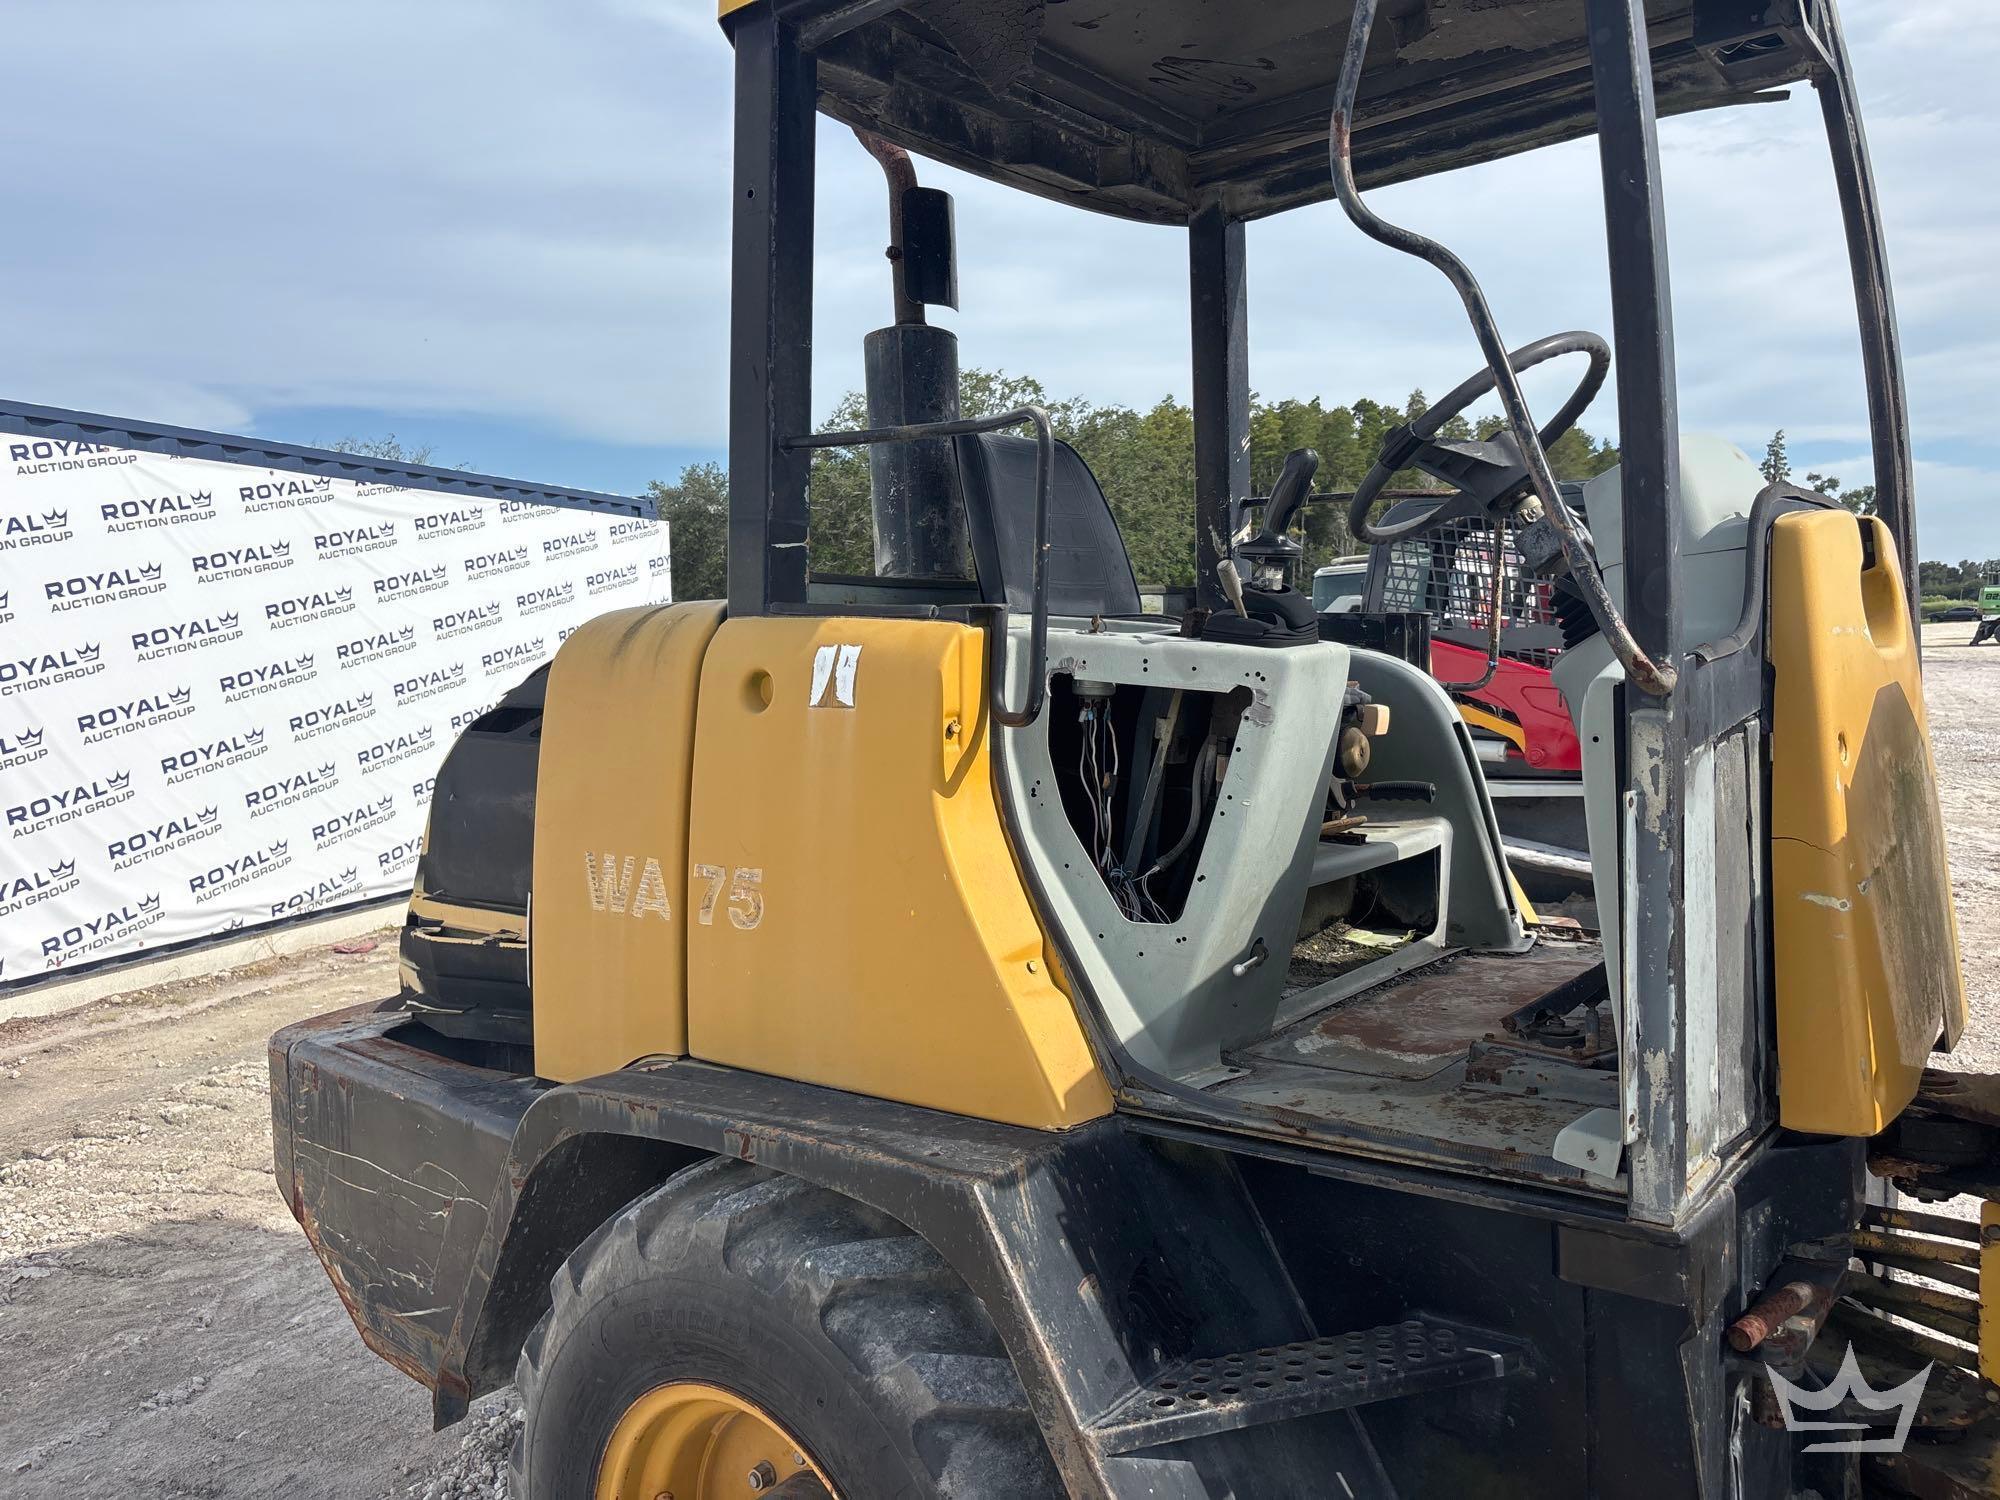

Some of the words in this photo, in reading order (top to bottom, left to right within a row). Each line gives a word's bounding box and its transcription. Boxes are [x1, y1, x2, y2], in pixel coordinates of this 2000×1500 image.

[17, 460, 84, 475] AUCTION
[87, 455, 137, 468] GROUP
[239, 480, 314, 502] ROYAL
[244, 500, 295, 513] AUCTION
[297, 494, 334, 506] GROUP
[101, 495, 191, 520] ROYAL
[414, 510, 470, 531] ROYAL
[502, 512, 534, 524] AUCTION
[107, 517, 168, 533] AUCTION
[171, 511, 216, 524] GROUP
[418, 528, 455, 541] AUCTION
[457, 522, 485, 532] GROUP
[610, 520, 648, 537] ROYAL
[20, 531, 73, 547] GROUP
[314, 527, 380, 549] ROYAL
[318, 546, 363, 560] AUCTION
[365, 539, 398, 552] GROUP
[543, 533, 586, 553] ROYAL
[612, 535, 638, 546] AUCTION
[640, 529, 659, 539] GROUP
[192, 546, 272, 572] ROYAL
[464, 550, 516, 572] ROYAL
[546, 550, 575, 562] AUCTION
[576, 544, 598, 554] GROUP
[649, 555, 671, 569] ROY
[45, 569, 140, 600] ROYAL
[198, 567, 252, 584] AUCTION
[255, 559, 294, 573] GROUP
[374, 569, 433, 593] ROYAL
[468, 568, 503, 581] AUCTION
[505, 561, 530, 572] GROUP
[587, 568, 627, 587] ROYAL
[51, 593, 116, 613] AUCTION
[119, 583, 167, 599] GROUP
[378, 588, 418, 604] AUCTION
[419, 580, 449, 593] GROUP
[517, 586, 562, 608] ROYAL
[589, 583, 617, 596] AUCTION
[618, 577, 638, 588] GROUP
[265, 592, 336, 619] ROYAL
[270, 612, 319, 631] AUCTION
[320, 604, 356, 618] GROUP
[520, 602, 551, 617] AUCTION
[552, 595, 575, 608] GROUP
[433, 607, 487, 632] ROYAL
[436, 625, 473, 641] AUCTION
[475, 617, 502, 630] GROUP
[132, 618, 219, 650] ROYAL
[137, 641, 197, 662] AUCTION
[200, 630, 243, 648] GROUP
[337, 632, 399, 659] ROYAL
[0, 651, 77, 682] OYAL
[341, 652, 383, 670] AUCTION
[385, 642, 417, 657] GROUP
[482, 643, 532, 668] ROYAL
[485, 661, 519, 677] AUCTION
[521, 651, 546, 665] GROUP
[1, 676, 51, 696] CTION
[53, 663, 105, 683] GROUP
[220, 661, 297, 692] ROYAL
[225, 682, 277, 704] AUCTION
[280, 671, 318, 687] GROUP
[394, 669, 450, 697] ROYAL
[397, 689, 436, 707] AUCTION
[438, 678, 466, 693] GROUP
[78, 696, 169, 732] ROYAL
[83, 720, 146, 745] AUCTION
[148, 705, 196, 725] GROUP
[290, 700, 357, 732] ROYAL
[294, 722, 340, 743] AUCTION
[342, 709, 376, 726] GROUP
[451, 702, 500, 729] ROYA
[161, 737, 245, 774] ROYAL
[358, 733, 418, 765] ROYAL
[362, 754, 403, 775] AUCTION
[405, 741, 435, 758] GROUP
[167, 760, 224, 786] AUCTION
[227, 745, 268, 765] GROUP
[246, 771, 319, 808] ROYAL
[250, 794, 300, 819] AUCTION
[302, 779, 339, 798] GROUP
[6, 782, 108, 825] ROYAL
[13, 808, 82, 839] AUCTION
[85, 790, 135, 814] GROUP
[312, 805, 378, 840] ROYAL
[317, 827, 362, 851] AUCTION
[363, 810, 396, 830] GROUP
[108, 817, 197, 860] ROYAL
[114, 841, 175, 872] AUCTION
[177, 824, 222, 847] GROUP
[189, 850, 270, 893] ROYAL
[196, 875, 249, 904] AUCTION
[252, 856, 292, 879] GROUP
[26, 878, 80, 905] GROUP
[271, 878, 342, 917] ROYAL
[326, 882, 363, 903] GROUP
[584, 850, 672, 921] WA
[694, 863, 764, 930] 75
[41, 907, 138, 956] ROYAL
[46, 933, 114, 969] AUCTION
[117, 911, 166, 938] GROUP
